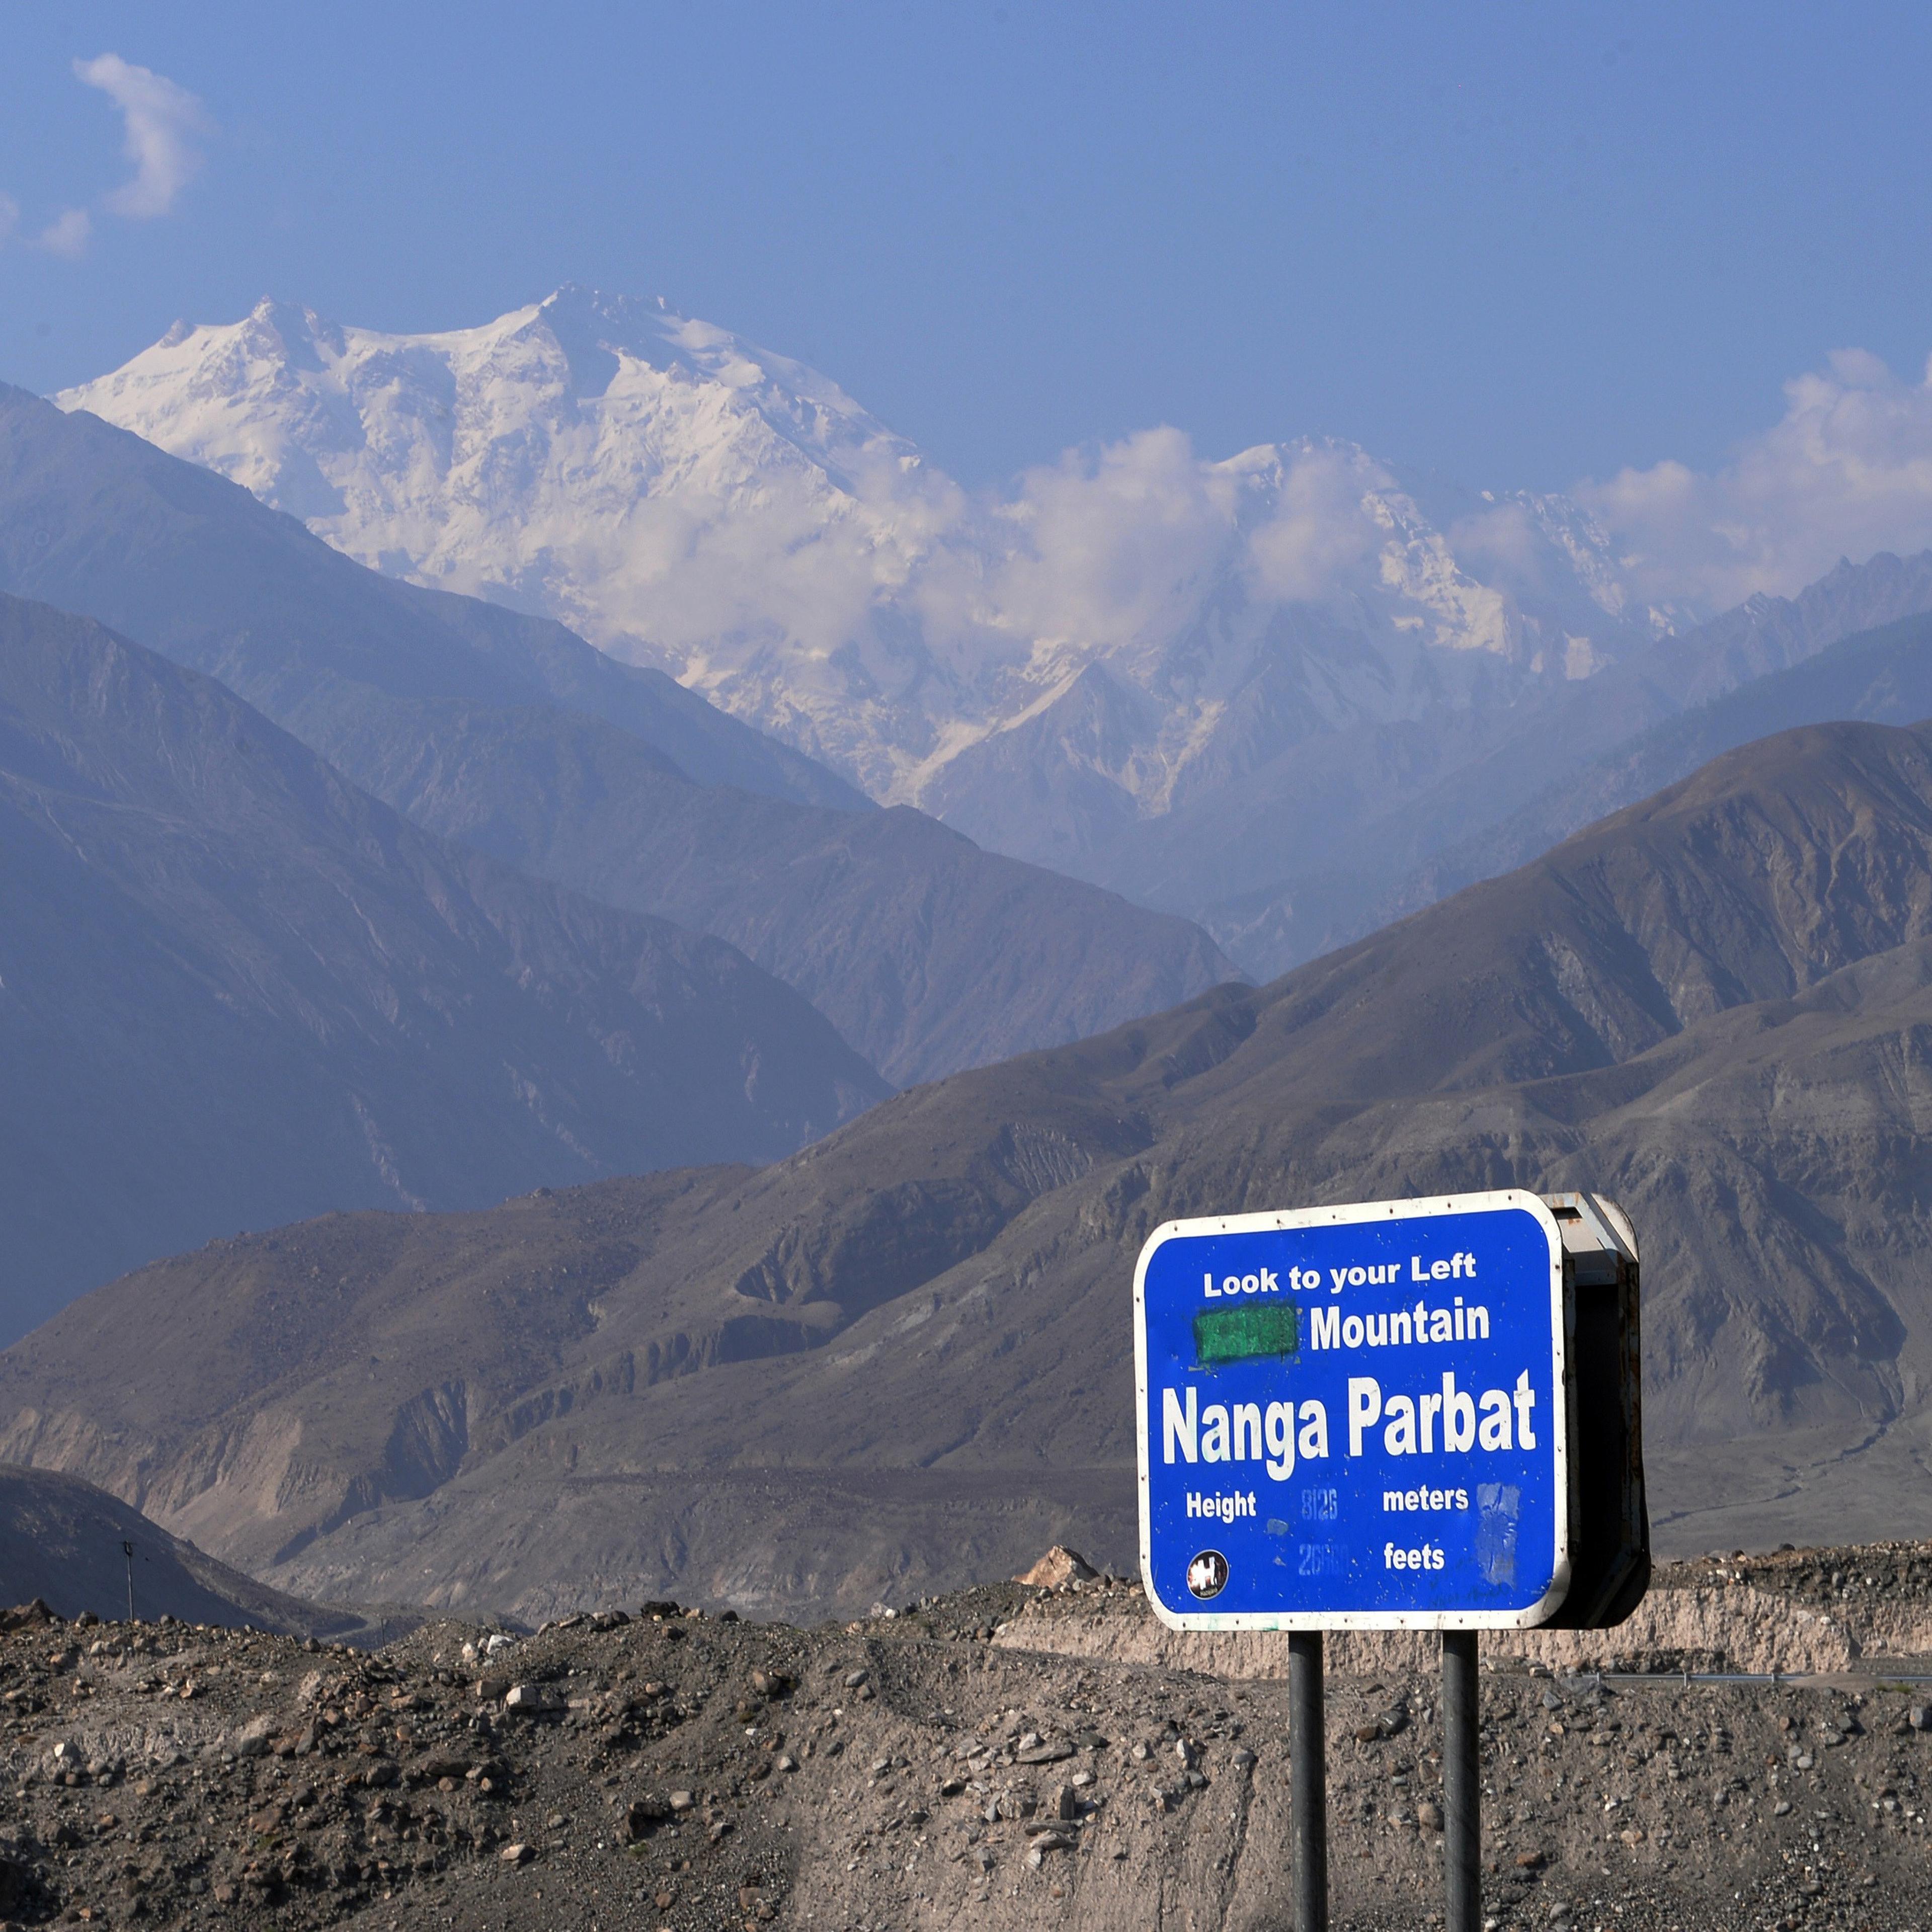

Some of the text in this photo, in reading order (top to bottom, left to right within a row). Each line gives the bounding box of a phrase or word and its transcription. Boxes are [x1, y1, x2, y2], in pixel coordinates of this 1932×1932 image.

[1203, 1252, 1477, 1298] Look to your Left
[1310, 1296, 1490, 1351] Mountain
[1162, 1368, 1537, 1482] Nanga Parbat
[1186, 1490, 1257, 1524] Height
[1383, 1484, 1469, 1512] meters
[1383, 1542, 1445, 1570] feets
